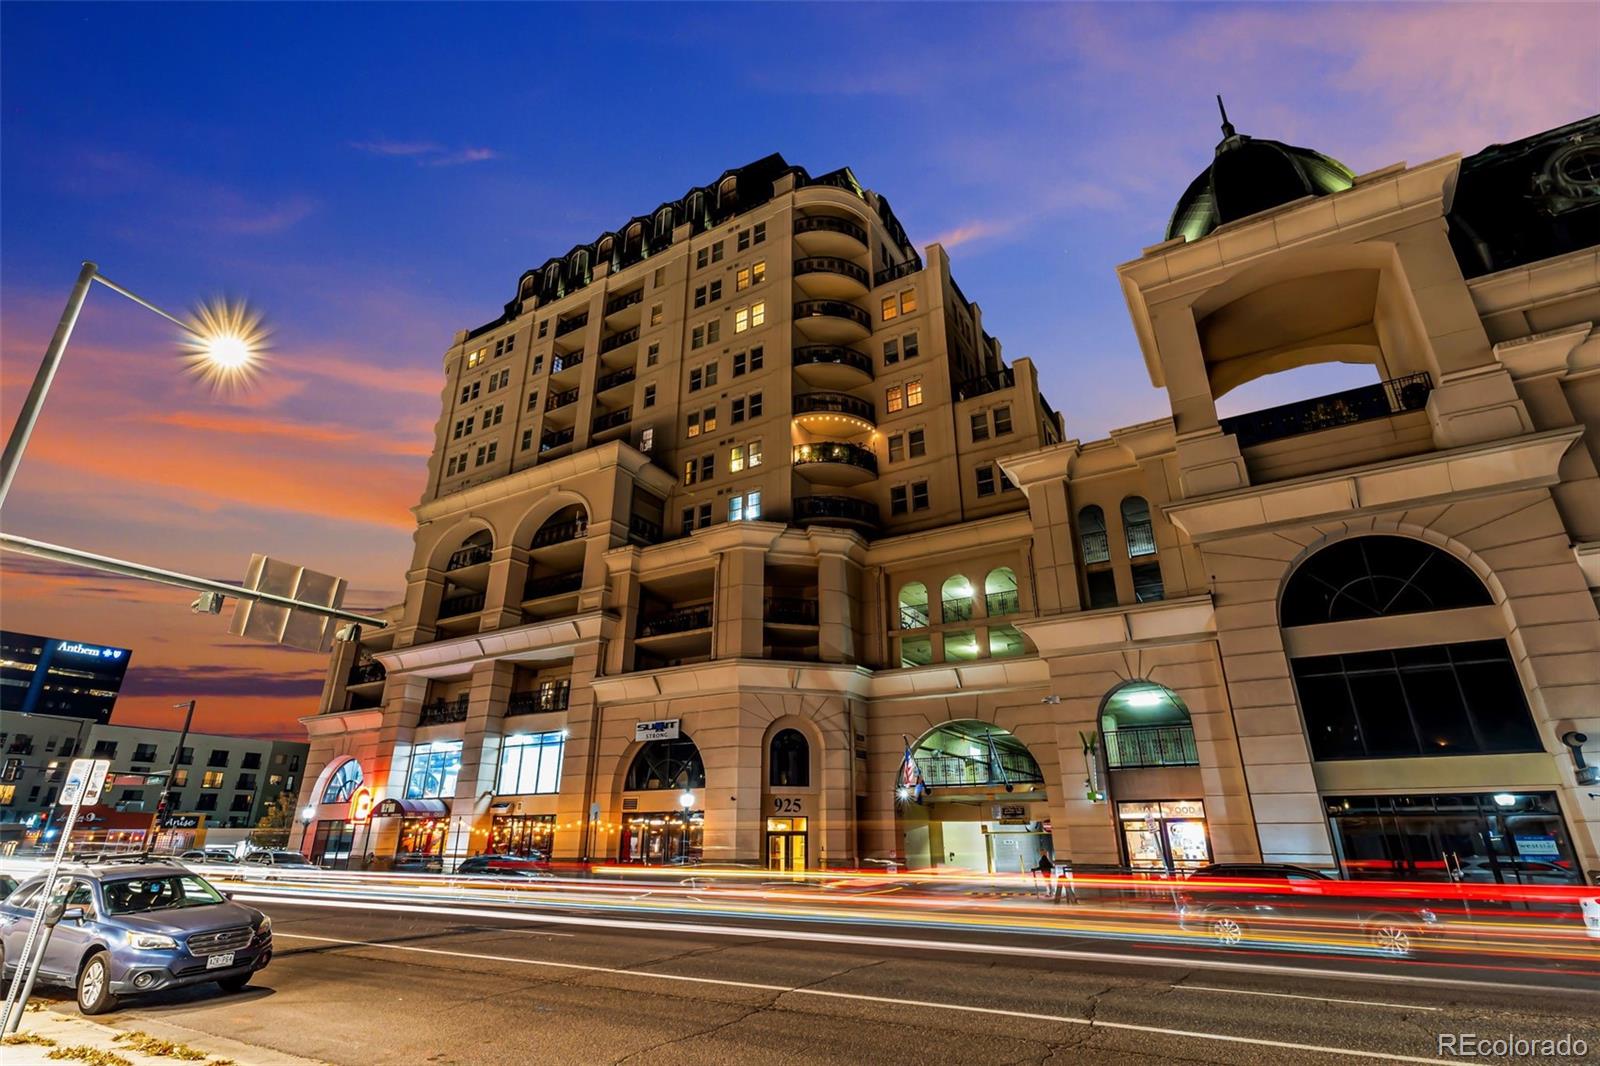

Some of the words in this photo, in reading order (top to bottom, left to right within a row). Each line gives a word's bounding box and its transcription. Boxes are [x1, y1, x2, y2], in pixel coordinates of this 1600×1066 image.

[57, 641, 100, 656] Anthem
[637, 721, 678, 732] SUIT
[774, 798, 802, 813] 925
[165, 817, 196, 827] Anise
